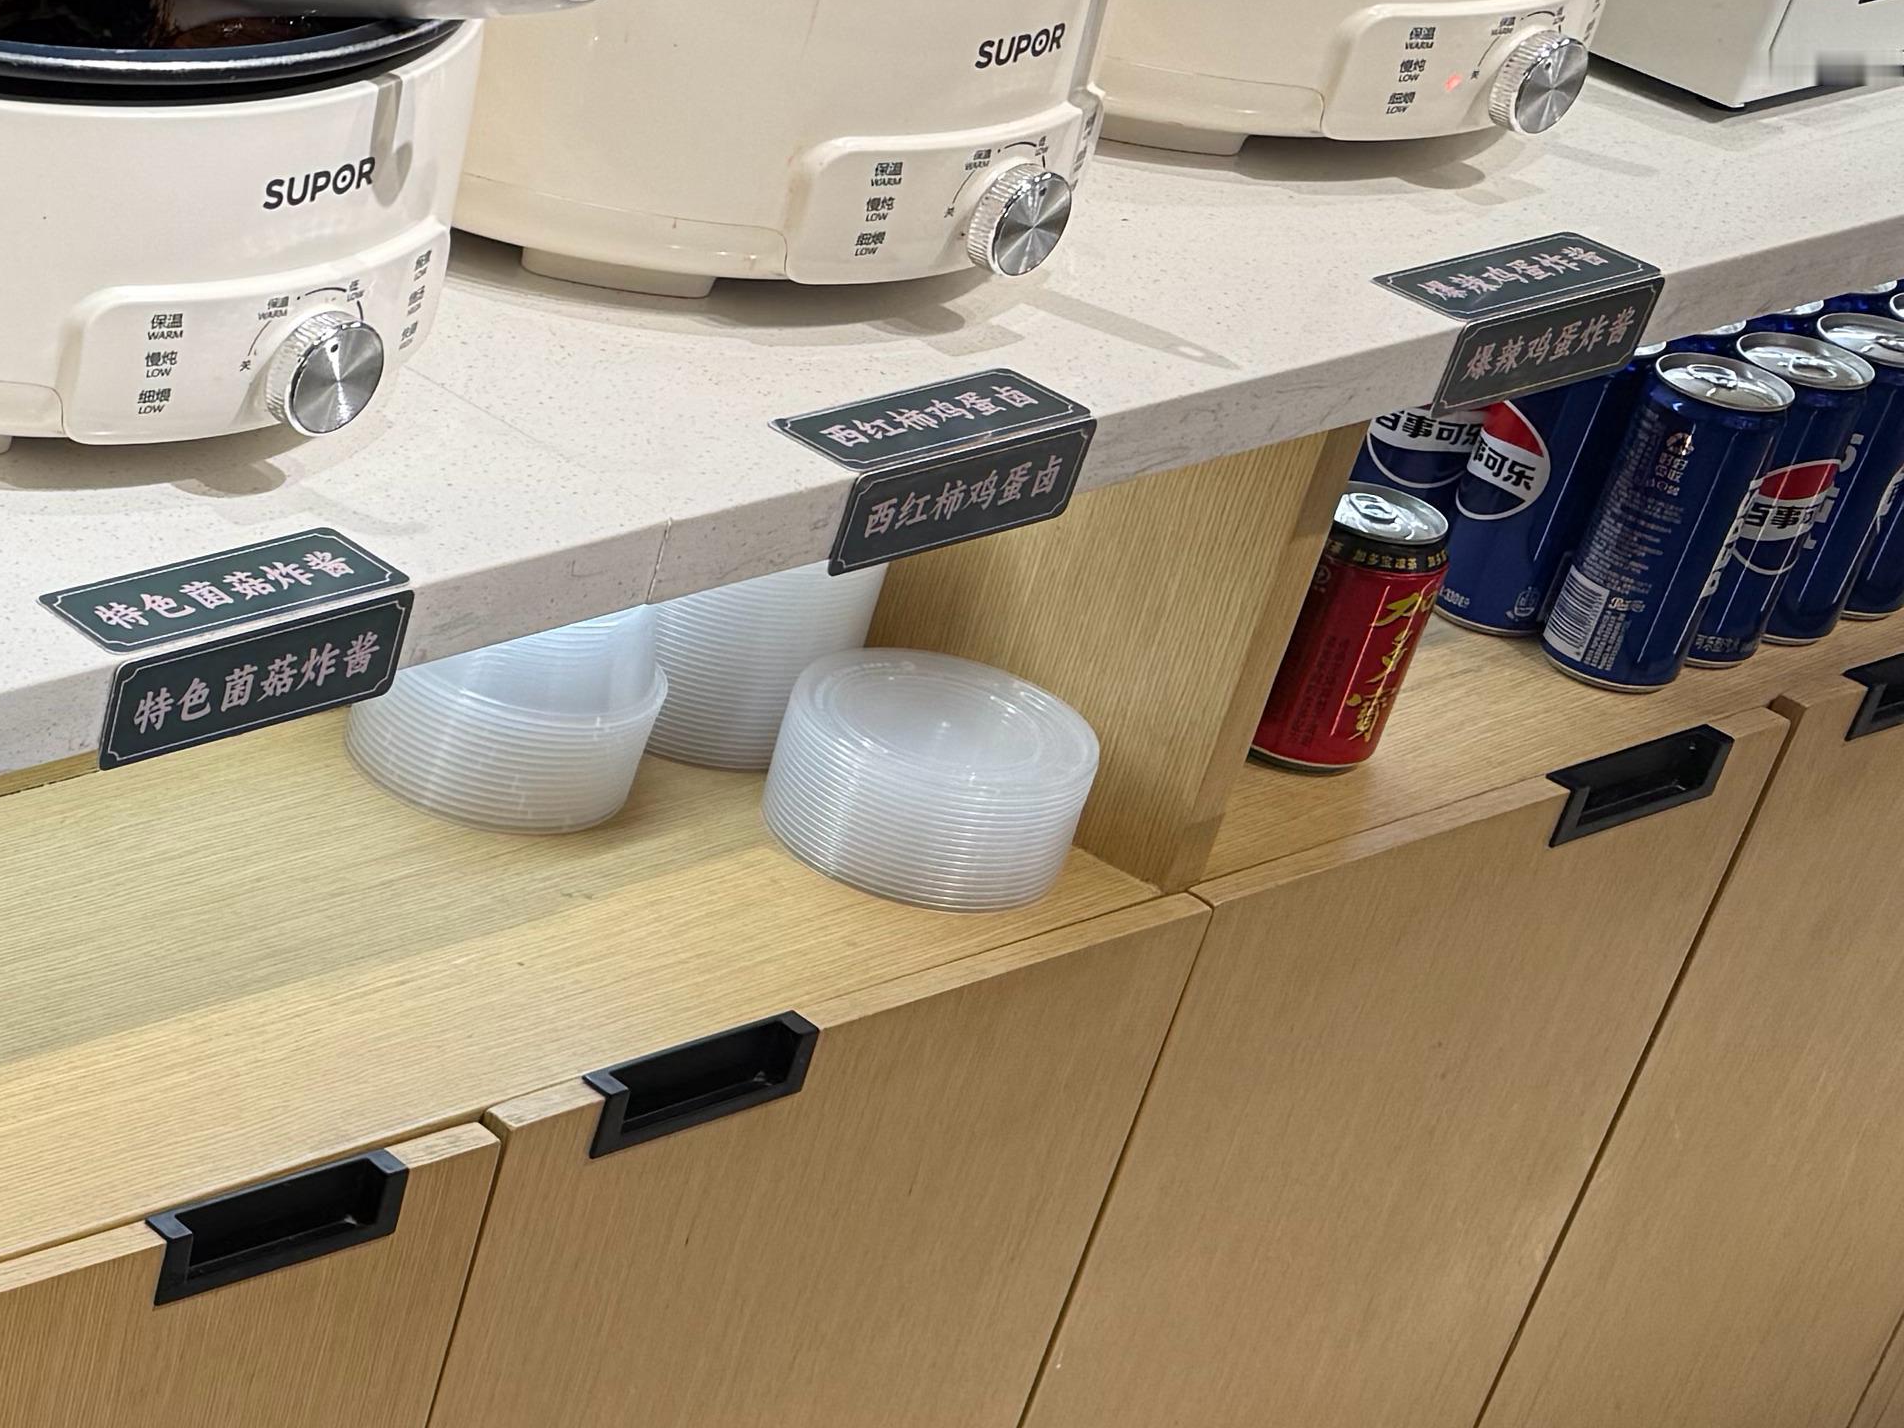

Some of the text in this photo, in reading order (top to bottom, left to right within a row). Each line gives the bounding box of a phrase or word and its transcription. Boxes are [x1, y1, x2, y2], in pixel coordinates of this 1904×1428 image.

[975, 22, 1065, 71] SUPOR
[262, 155, 375, 210] SUPOR
[148, 330, 183, 340] WARM
[151, 314, 183, 329] 保温
[146, 368, 171, 378] LOW
[138, 404, 164, 414] LOW
[820, 381, 1039, 450] 西红柿鸡蛋卤
[863, 453, 1061, 540] 西红柿鸡蛋卤
[94, 545, 355, 634] 特色菌菇炸酱
[132, 630, 381, 734] 特色菌菇炸酱
